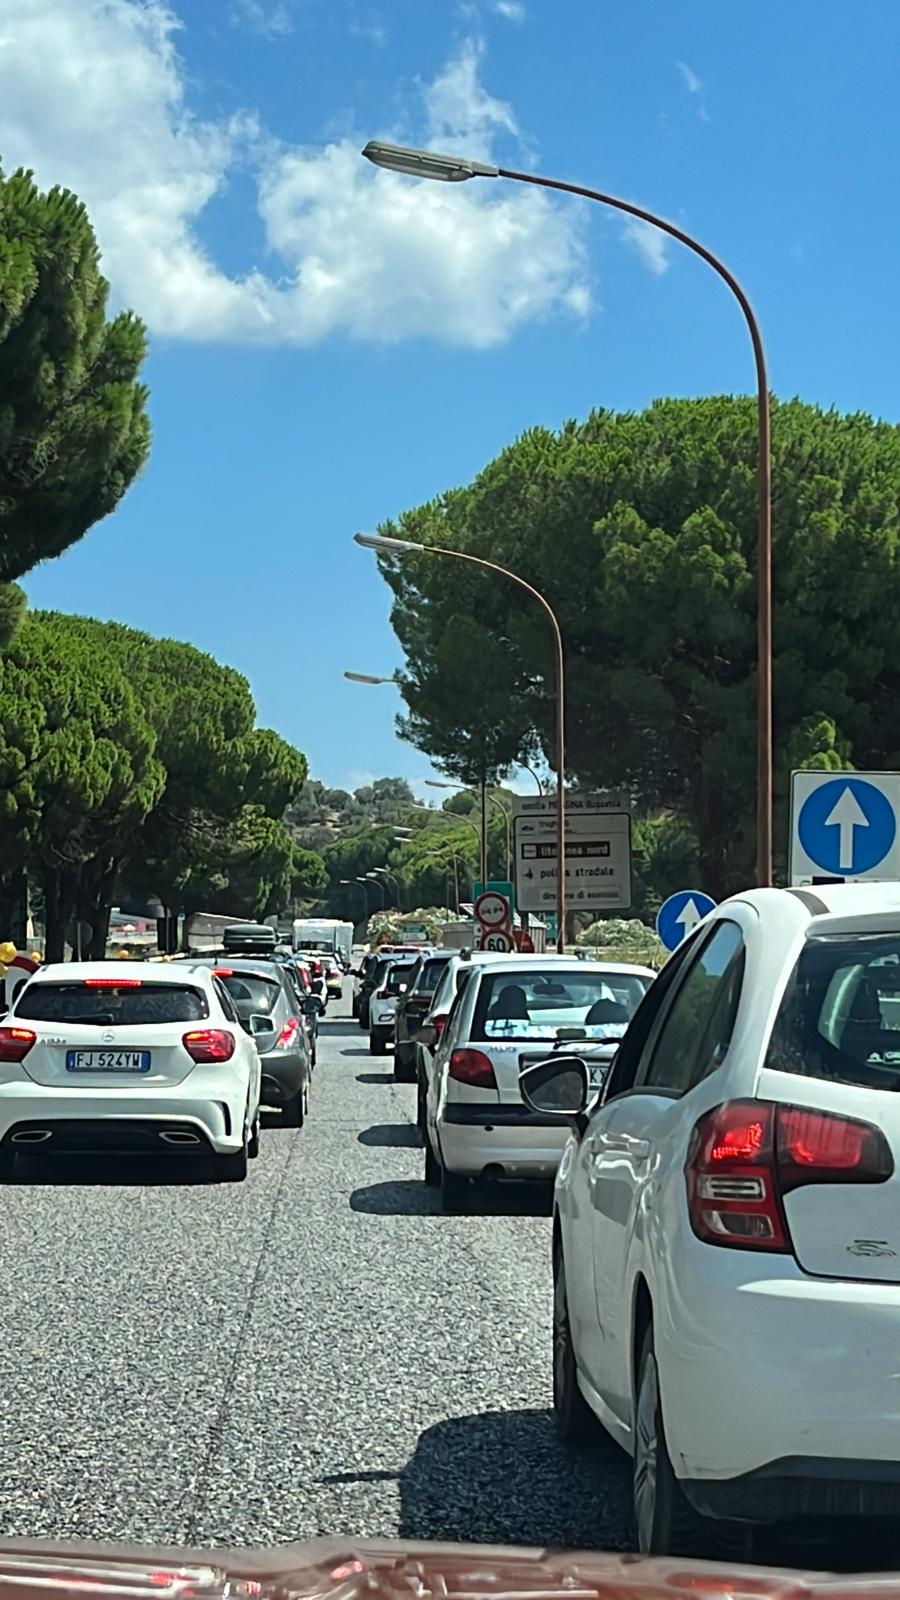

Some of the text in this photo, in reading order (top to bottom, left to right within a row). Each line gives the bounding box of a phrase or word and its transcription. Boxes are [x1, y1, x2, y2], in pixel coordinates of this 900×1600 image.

[575, 866, 614, 877] stradale
[487, 937, 506, 952] 60
[76, 1053, 93, 1067] FJ
[98, 1053, 140, 1067] 524YW
